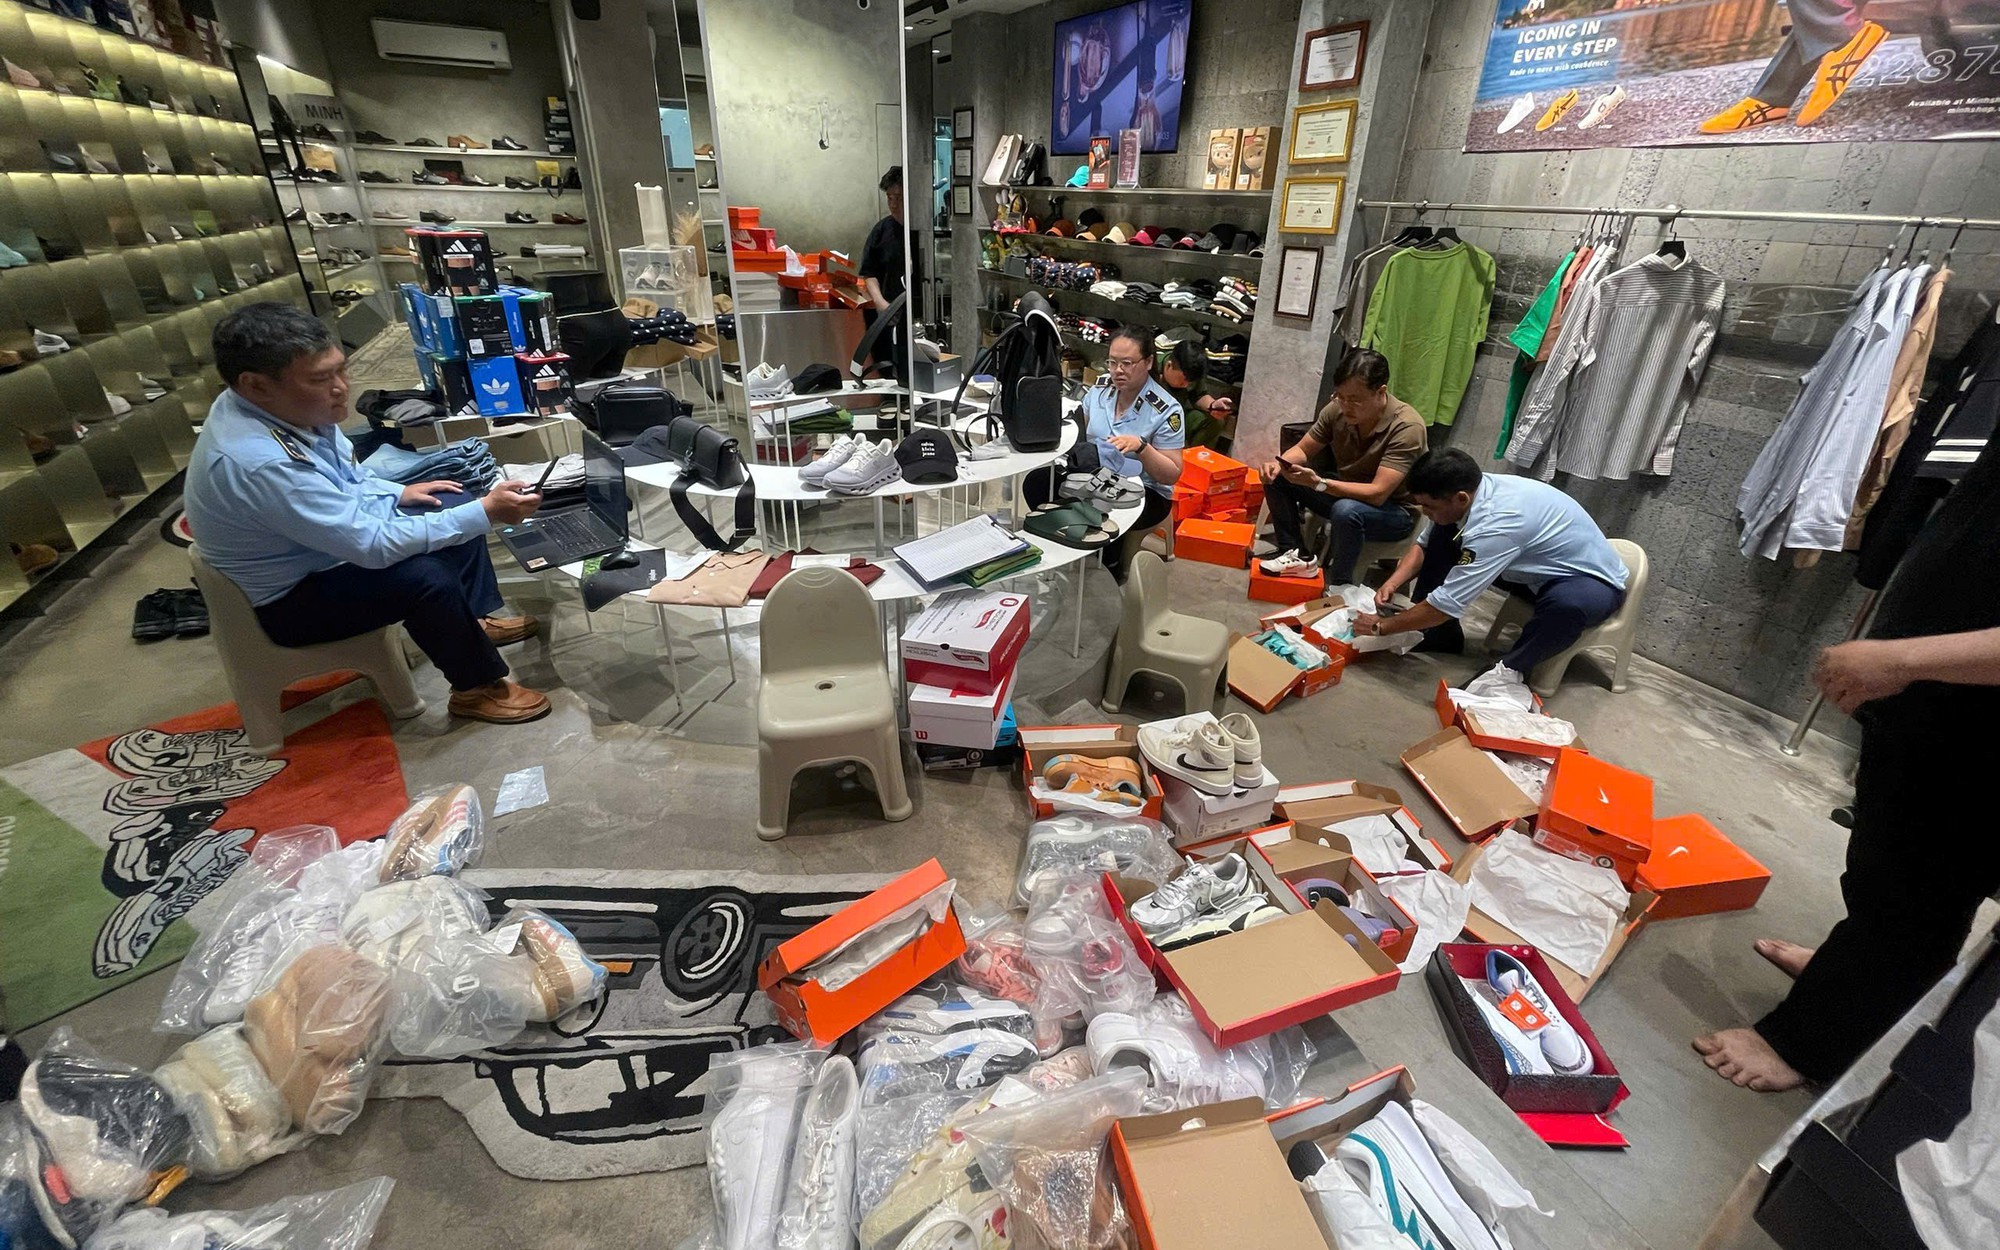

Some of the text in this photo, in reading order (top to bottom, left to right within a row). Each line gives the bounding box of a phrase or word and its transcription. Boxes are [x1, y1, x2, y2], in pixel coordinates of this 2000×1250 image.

[1517, 19, 1602, 45] ICONIC IN
[1512, 37, 1618, 64] EVERY STEP
[1509, 68, 1526, 77] Made
[1527, 67, 1535, 75] to
[1536, 65, 1553, 74] move
[1554, 63, 1570, 72] with
[304, 103, 344, 120] MINH
[1908, 99, 1952, 108] Available
[1953, 98, 1964, 106] at
